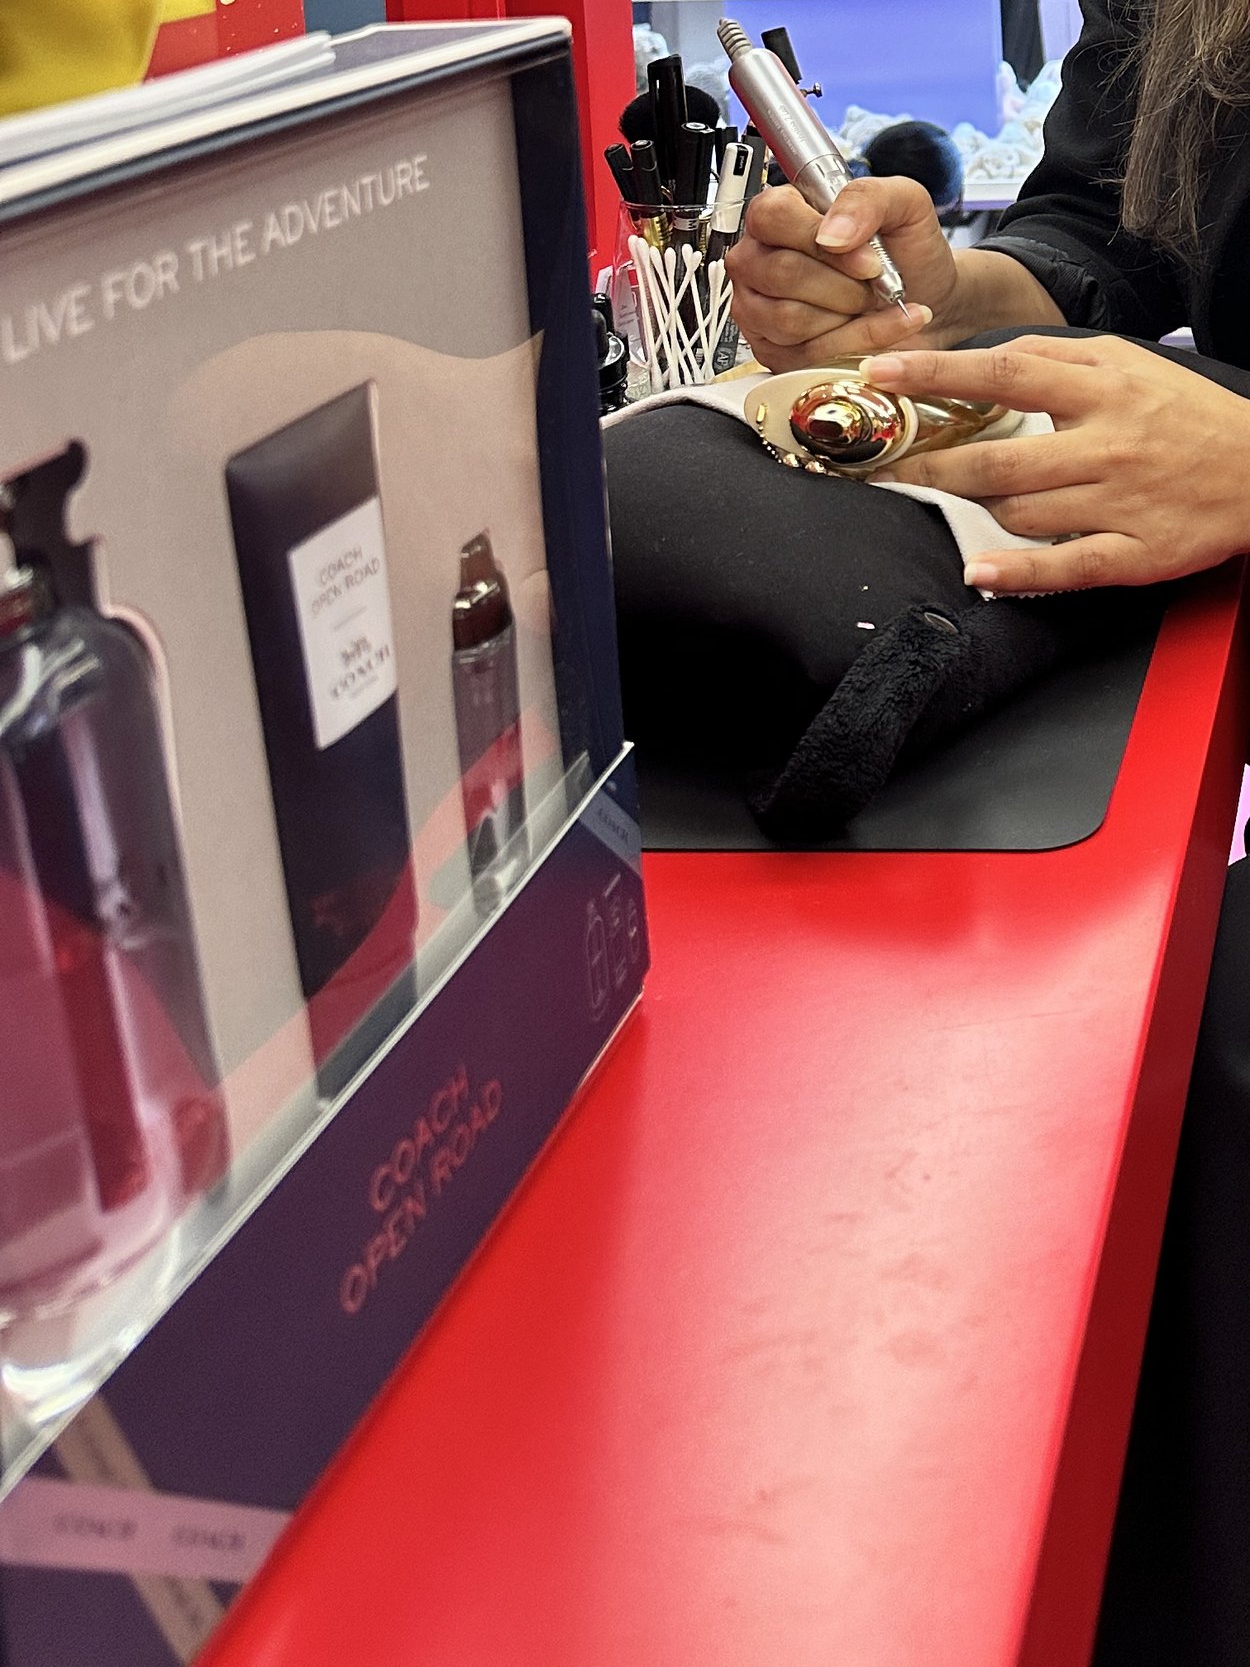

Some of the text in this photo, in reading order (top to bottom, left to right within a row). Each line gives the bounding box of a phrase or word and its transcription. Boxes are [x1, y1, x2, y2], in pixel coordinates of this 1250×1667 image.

[2, 154, 431, 365] LIVE FOR THE ADVENTURE
[311, 557, 381, 618] OPEN ROAD
[319, 545, 363, 585] COACH
[339, 1080, 502, 1314] OPEN ROAD
[369, 1063, 468, 1211] COACH
